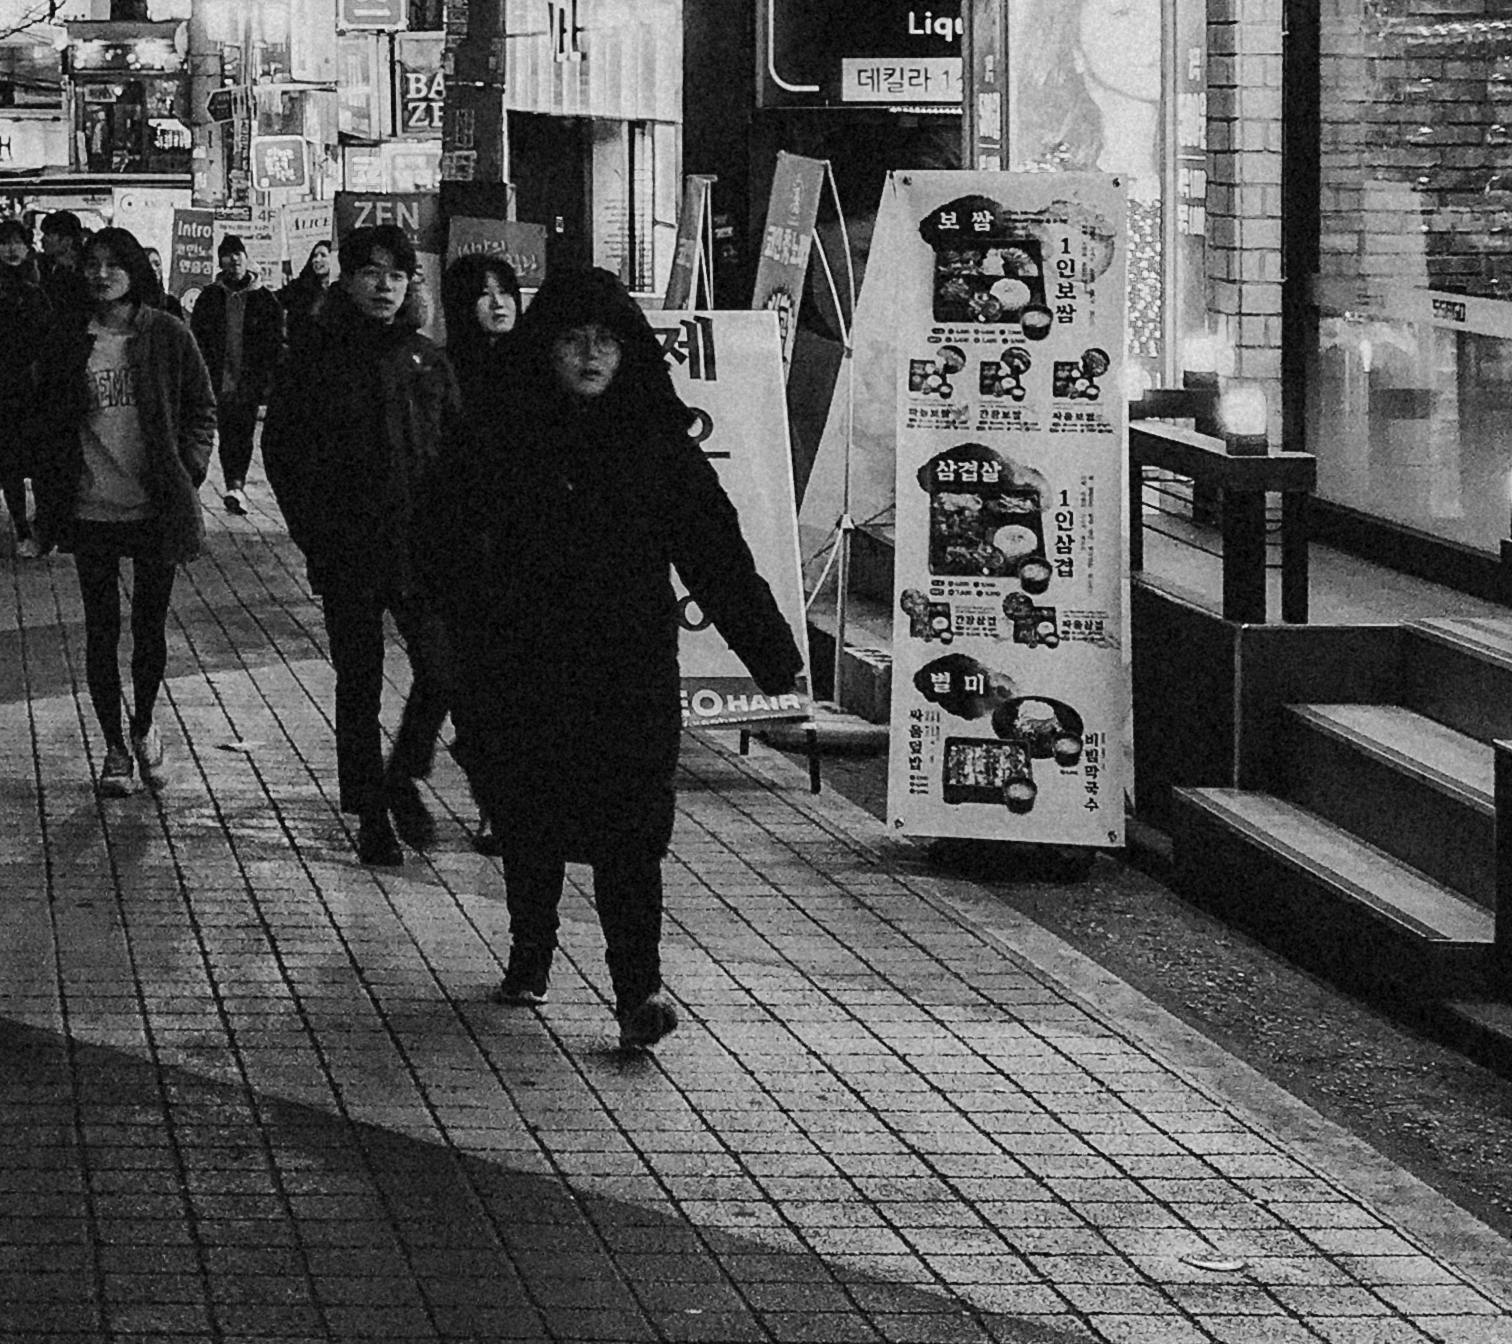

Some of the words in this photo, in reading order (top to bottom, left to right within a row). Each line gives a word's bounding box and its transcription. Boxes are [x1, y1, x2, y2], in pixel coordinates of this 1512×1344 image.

[856, 66, 933, 94] 데킬라
[257, 205, 277, 222] 4F
[353, 200, 420, 231] ZEN
[937, 210, 996, 232] 보쌈
[177, 220, 212, 238] Intro
[1054, 236, 1078, 326] 1인보쌈
[934, 458, 1003, 484] 삼겹살
[1052, 488, 1076, 579] 1인삼겹
